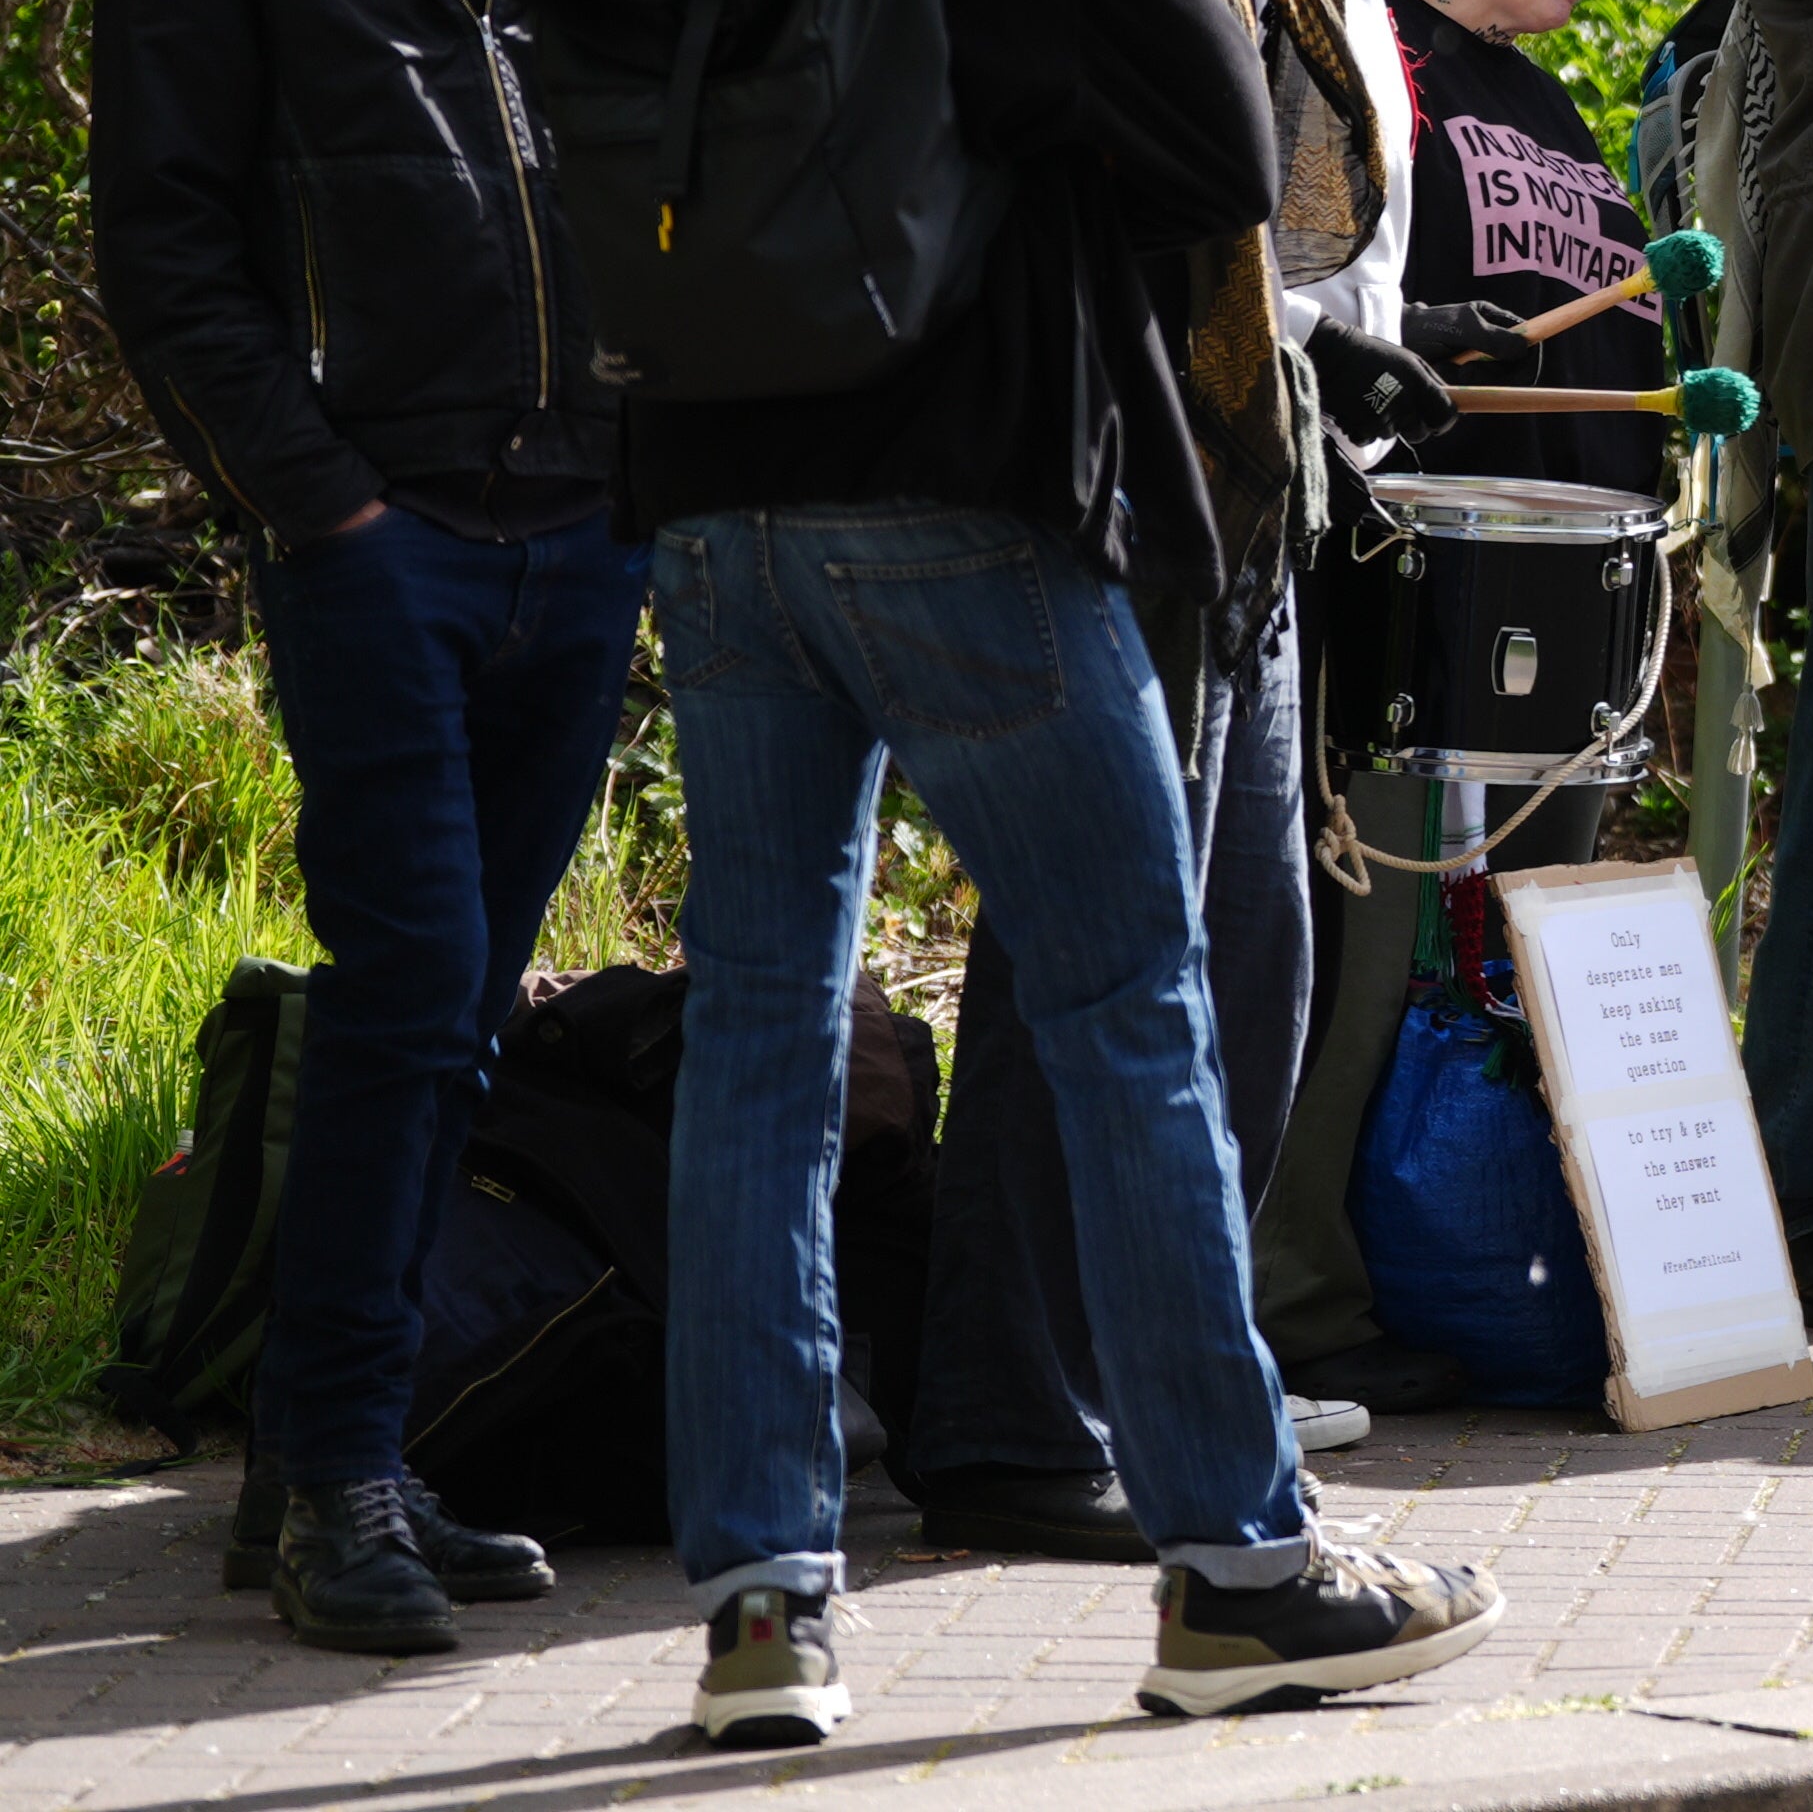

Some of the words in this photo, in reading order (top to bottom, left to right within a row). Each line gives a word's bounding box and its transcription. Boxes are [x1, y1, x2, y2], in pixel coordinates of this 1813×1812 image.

[1461, 125, 1630, 201] INJUSTICE
[1478, 170, 1520, 208] IS
[1523, 172, 1585, 224] NOT
[1610, 930, 1640, 948] Only
[1586, 966, 1652, 987] desperate
[1659, 963, 1682, 976] men
[1600, 1003, 1631, 1020] keep
[1639, 996, 1682, 1013] asking
[1620, 1032, 1642, 1047] the
[1650, 1029, 1679, 1044] same
[1627, 1058, 1686, 1082] question
[1628, 1131, 1643, 1145] to
[1651, 1127, 1672, 1143] try
[1679, 1121, 1688, 1137] &
[1694, 1119, 1715, 1138] get
[1644, 1161, 1667, 1178] the
[1673, 1155, 1716, 1173] answer
[1656, 1194, 1685, 1211] they
[1691, 1188, 1721, 1205] want
